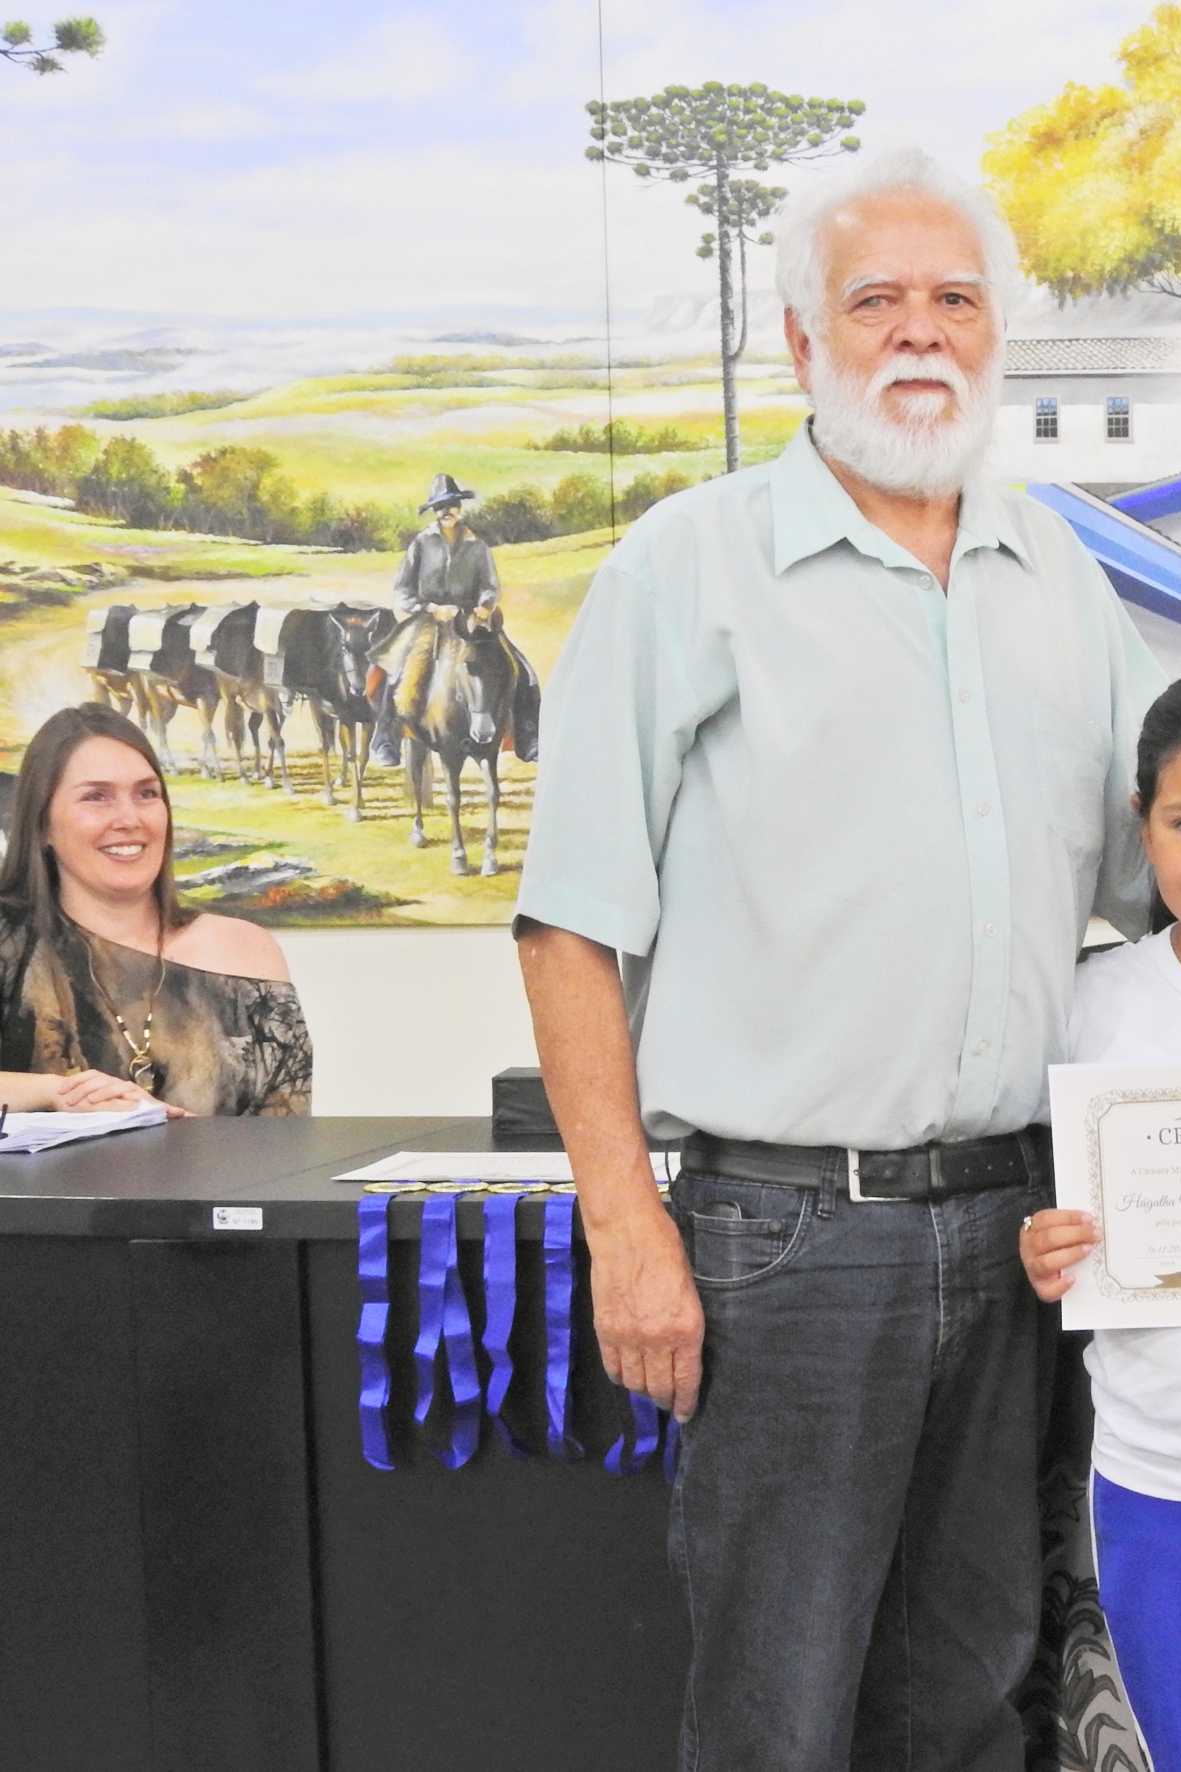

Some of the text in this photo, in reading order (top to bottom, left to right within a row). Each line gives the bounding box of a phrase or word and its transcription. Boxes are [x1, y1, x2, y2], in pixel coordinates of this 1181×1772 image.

[1130, 1168, 1137, 1176] A
[1138, 1166, 1169, 1175] Câmara
[1115, 1193, 1175, 1213] Hágatha
[1155, 1218, 1170, 1228] pela
